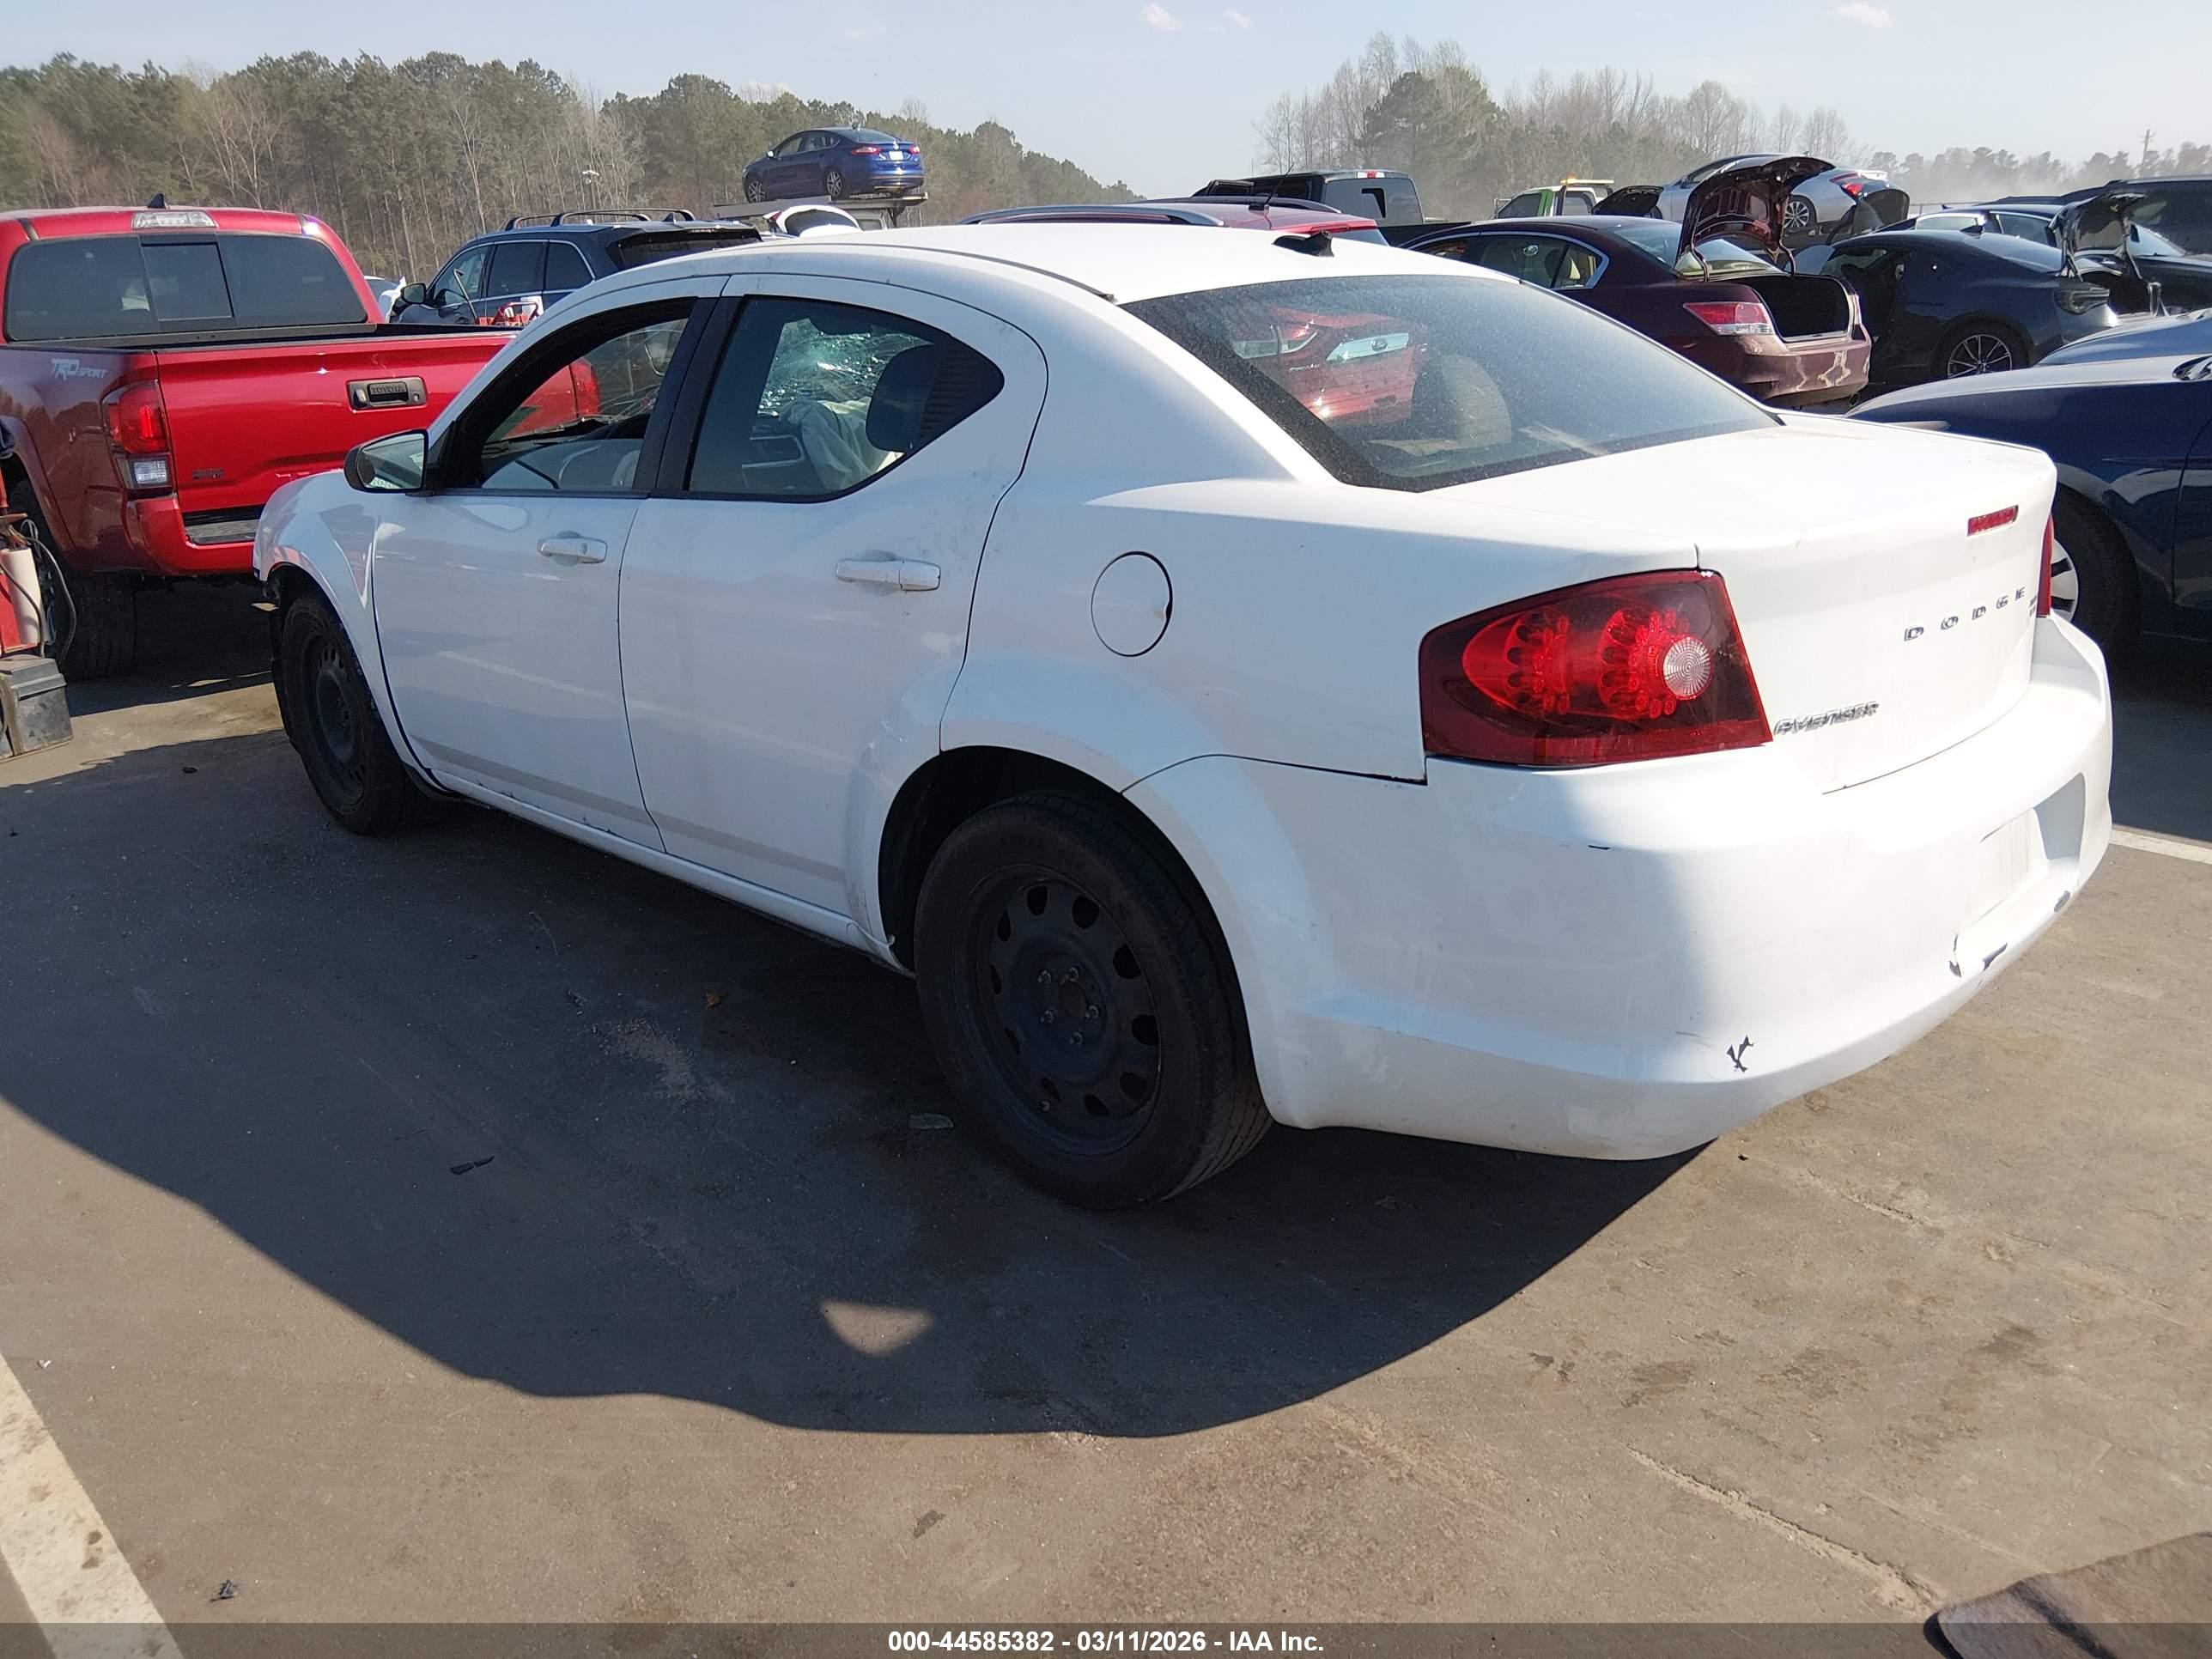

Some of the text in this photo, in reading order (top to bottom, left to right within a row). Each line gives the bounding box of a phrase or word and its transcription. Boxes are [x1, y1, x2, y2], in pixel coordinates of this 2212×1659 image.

[52, 358, 80, 380] TRD
[370, 385, 405, 394] TOYOTA
[1904, 586, 2025, 641] DODGE
